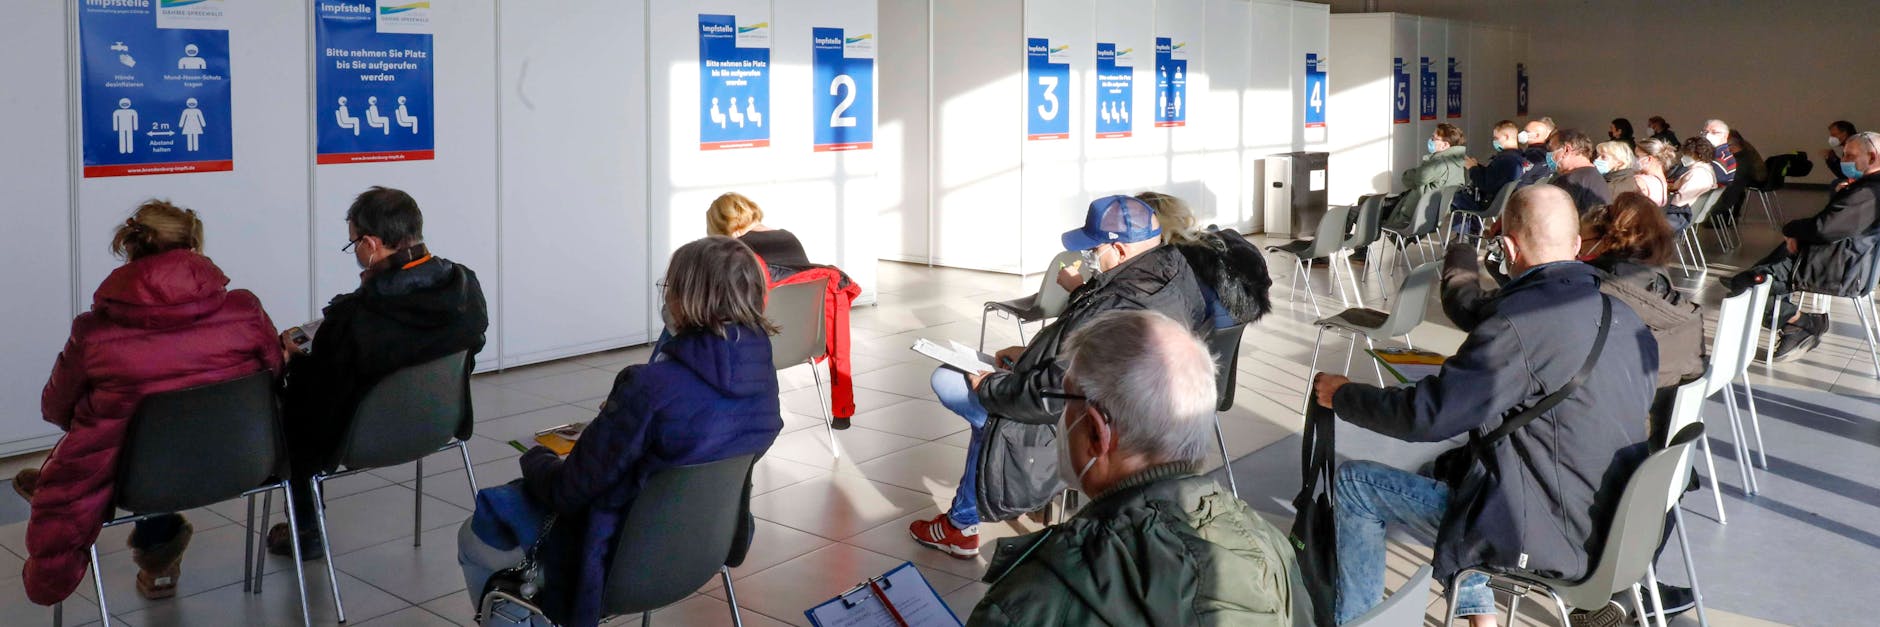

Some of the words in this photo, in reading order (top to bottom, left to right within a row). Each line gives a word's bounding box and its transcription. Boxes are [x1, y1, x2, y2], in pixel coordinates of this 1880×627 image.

[321, 3, 371, 14] Impfstelle
[326, 48, 348, 57] Bitte
[351, 49, 387, 57] nehmen
[389, 49, 402, 58] Sie
[405, 49, 426, 58] Platz
[336, 60, 350, 69] bis
[352, 61, 366, 69] Sie
[368, 61, 417, 71] aufgerufen
[360, 73, 395, 81] werden
[829, 74, 857, 127] 2
[1038, 76, 1059, 121] 3
[1310, 80, 1322, 113] 4
[1397, 82, 1406, 111] 5
[1520, 82, 1526, 106] 6
[152, 122, 159, 130] 2
